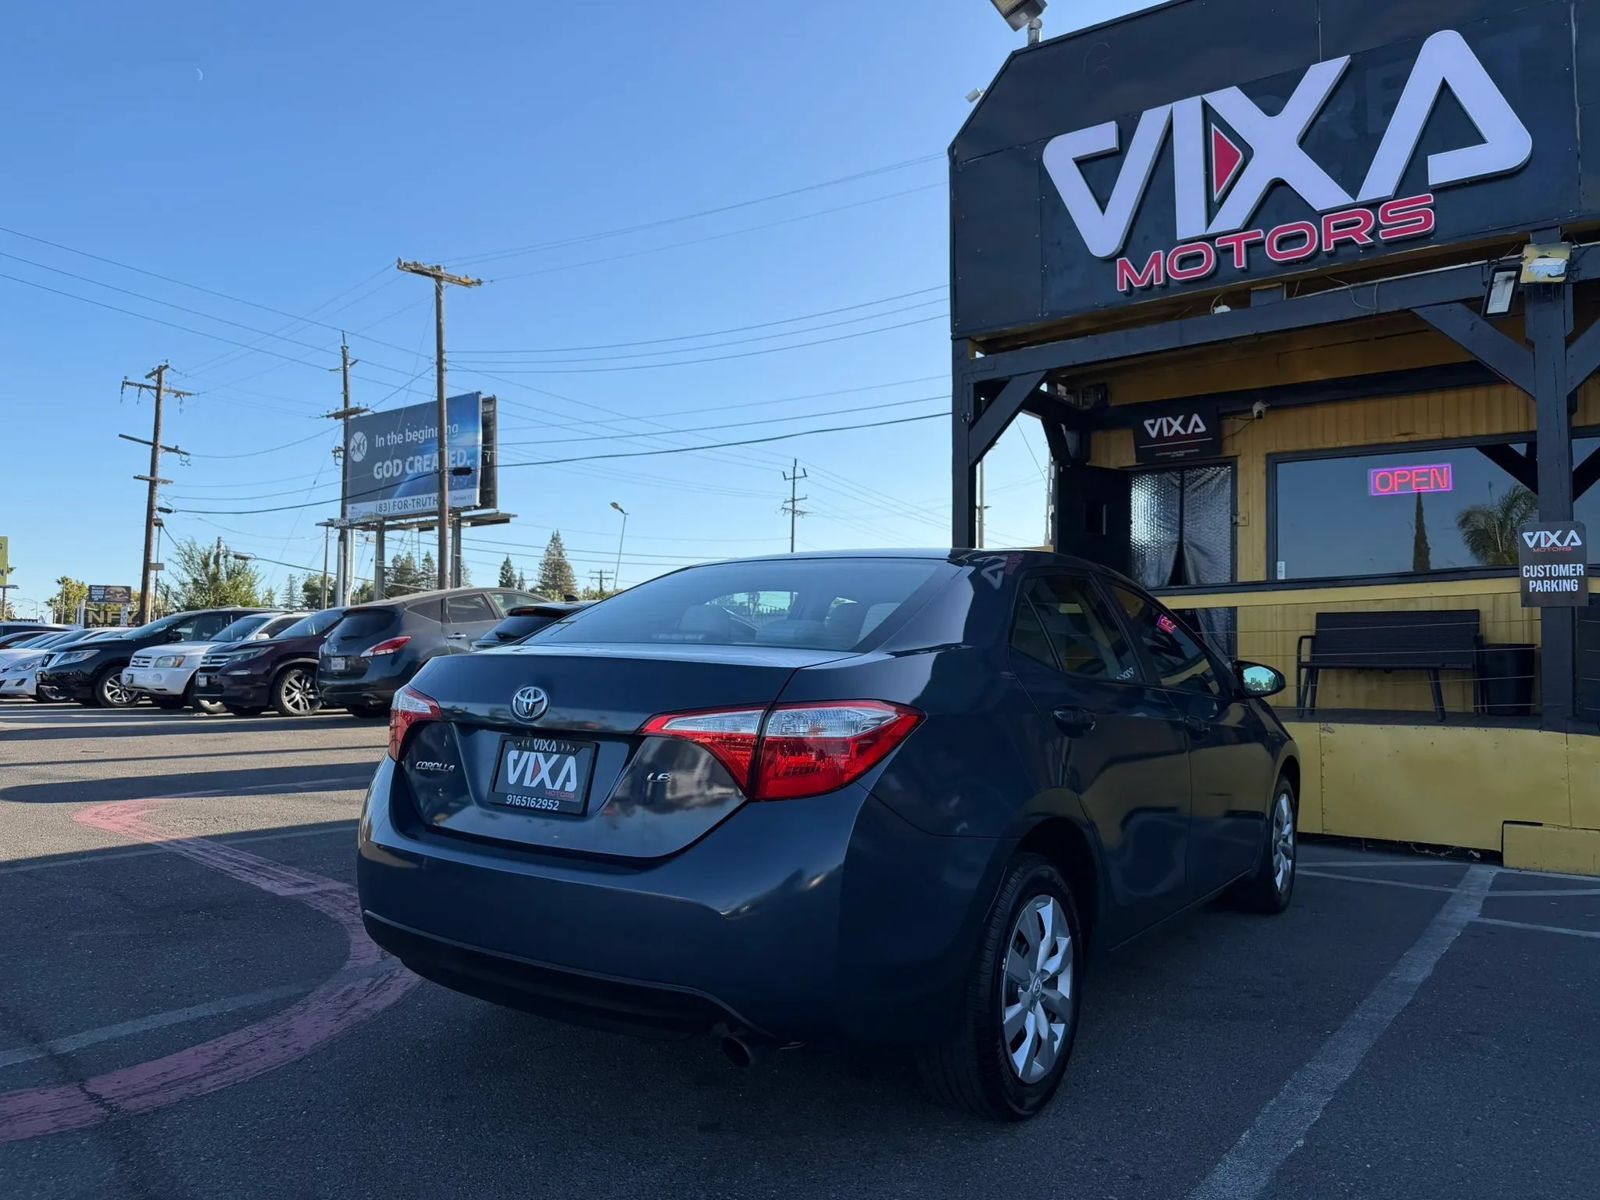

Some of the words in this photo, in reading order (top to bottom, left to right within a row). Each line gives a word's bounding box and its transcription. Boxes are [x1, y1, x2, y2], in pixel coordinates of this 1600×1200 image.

[1042, 29, 1533, 258] VIXA
[1115, 193, 1436, 292] MOTORS
[1143, 413, 1207, 438] VIXA
[375, 434, 385, 448] In
[386, 431, 404, 447] the
[373, 459, 402, 480] GOD
[405, 450, 471, 475] CREAED.
[1375, 467, 1449, 492] OPEN
[1522, 529, 1582, 548] VIXA
[1522, 563, 1584, 578] CUSTOMER
[1529, 578, 1579, 593] PARKING
[533, 738, 557, 752] VIXA
[415, 760, 455, 772] COROLLA
[507, 749, 578, 792] VIXA
[647, 772, 672, 783] LE
[505, 794, 560, 811] 9165162952
